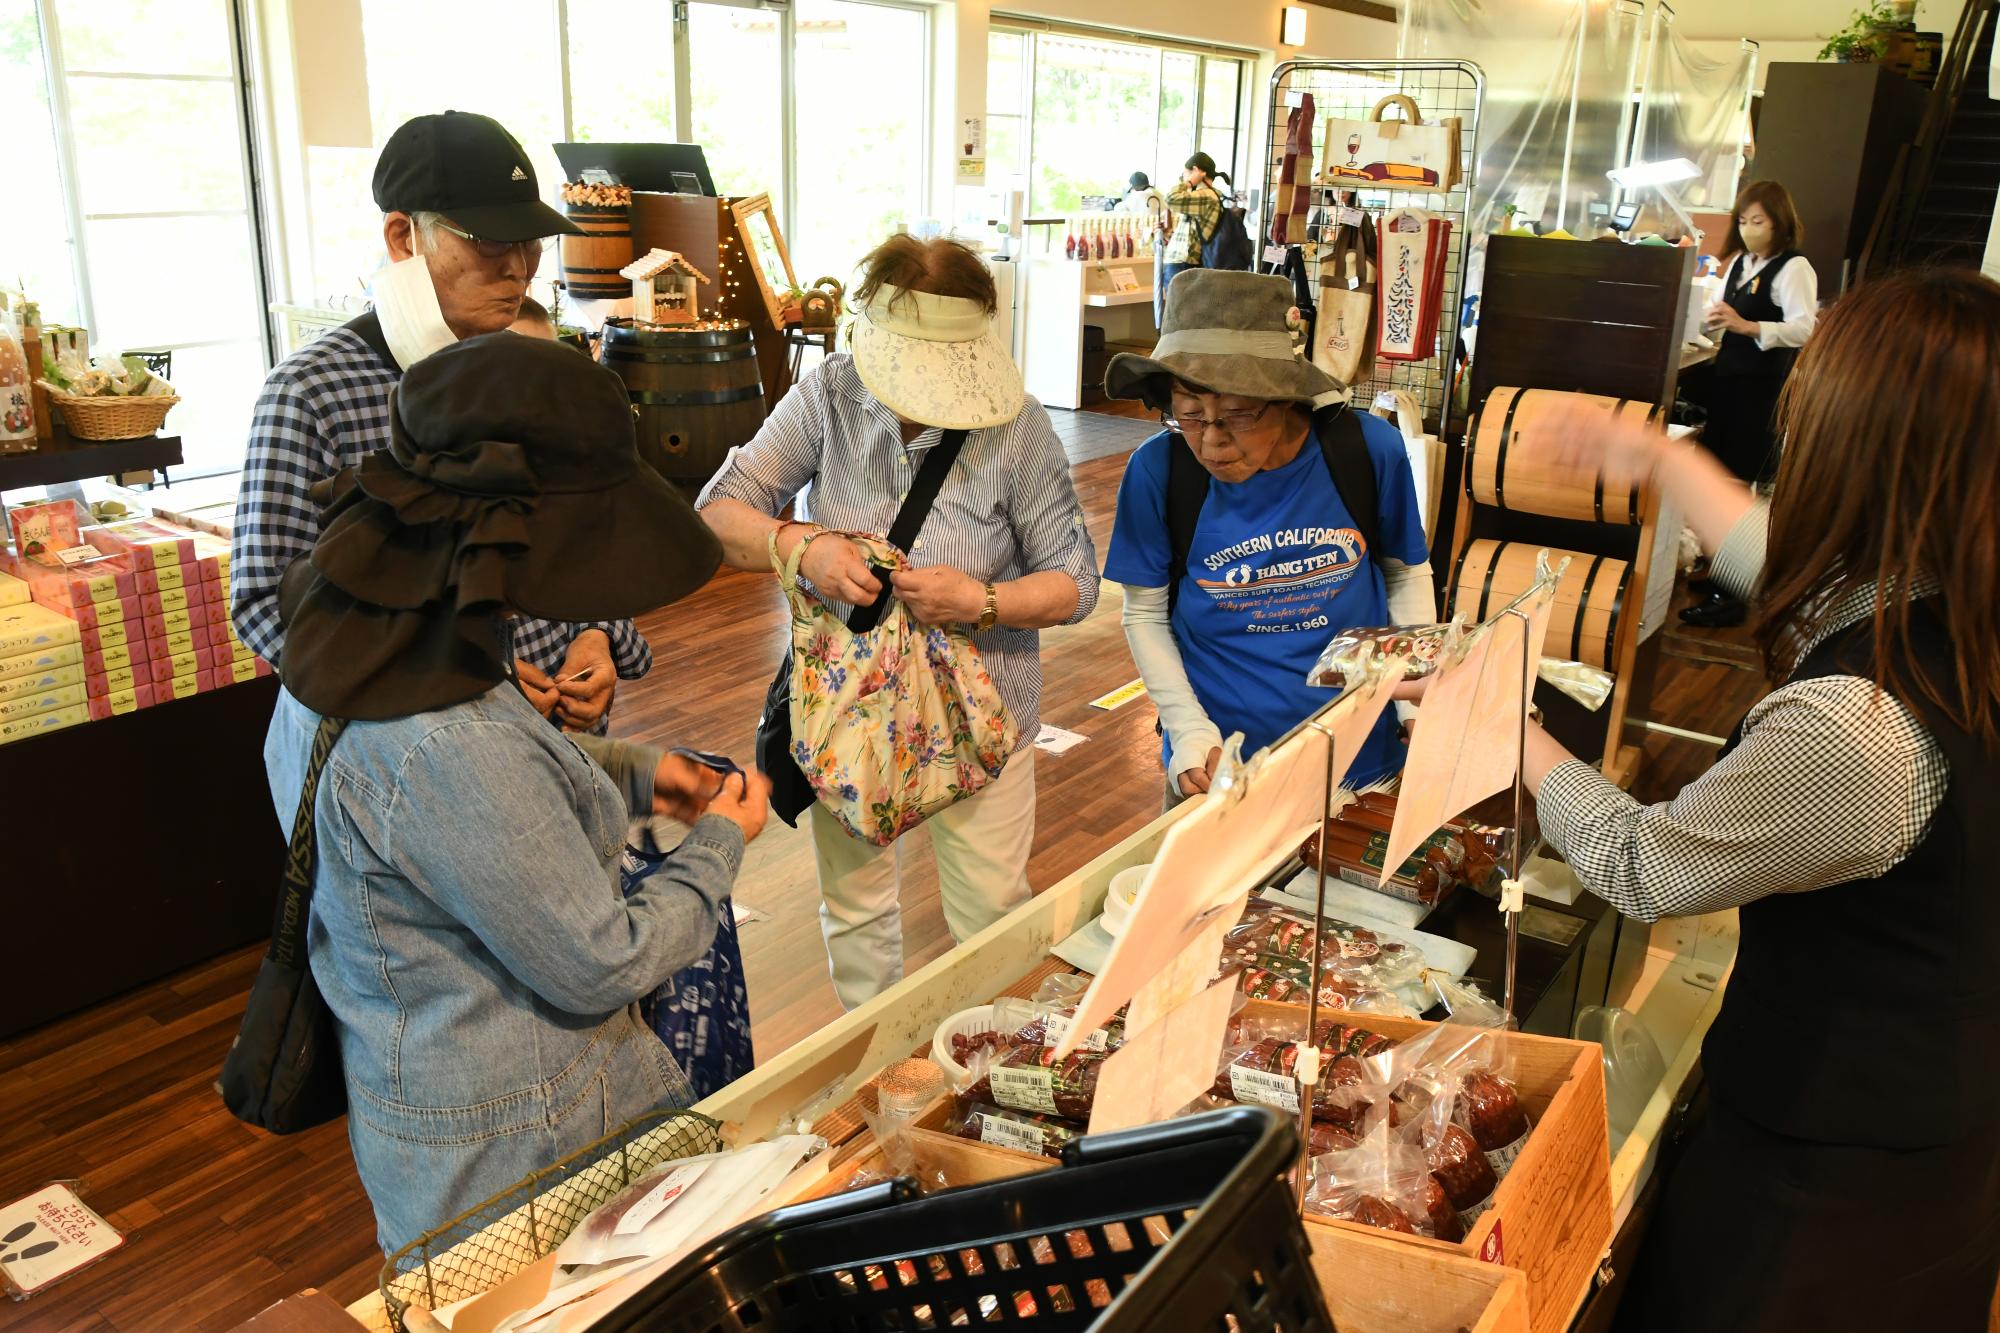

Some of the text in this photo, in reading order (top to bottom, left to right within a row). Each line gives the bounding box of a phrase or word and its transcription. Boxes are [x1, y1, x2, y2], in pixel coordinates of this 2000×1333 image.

[1203, 527, 1355, 572] SOUTHERN CALIFORNIA
[1256, 550, 1338, 580] HANG TEN
[1251, 588, 1271, 597] SURF
[1273, 585, 1303, 594] BOARD
[280, 886, 301, 937] MODA
[38, 1200, 93, 1247] お待ちください
[63, 1203, 97, 1229] こちらで
